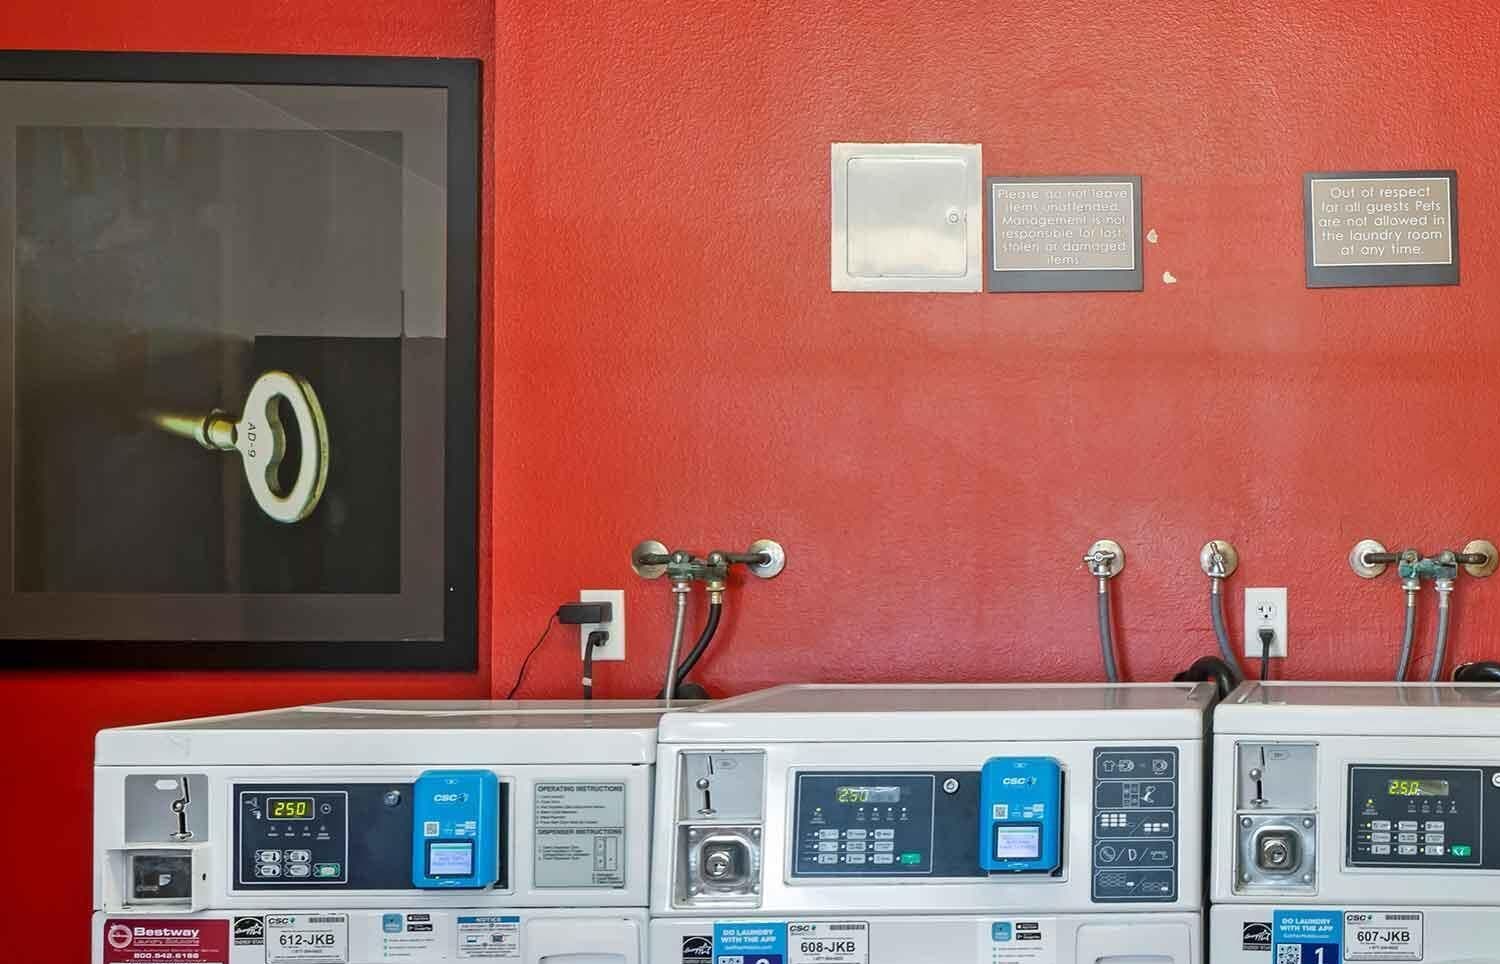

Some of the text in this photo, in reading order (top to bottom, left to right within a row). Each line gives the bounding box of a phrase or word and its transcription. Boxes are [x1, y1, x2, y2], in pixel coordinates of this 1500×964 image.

[1092, 188, 1128, 199] leave
[1330, 187, 1431, 200] Out of respect
[1321, 200, 1441, 214] for all guests Pets
[1002, 215, 1087, 227] Management
[1105, 215, 1127, 225] not
[1319, 214, 1446, 227] are not allowed in
[1002, 228, 1073, 240] responsible
[1079, 228, 1096, 239] for
[1321, 230, 1443, 243] the laundry room
[1063, 240, 1127, 253] damaged
[1341, 243, 1425, 258] at any time.
[134, 927, 199, 939] Bestway
[1357, 931, 1411, 942] 607-JKB
[280, 934, 336, 946] 612-JKB
[800, 941, 856, 953] 608-JKB
